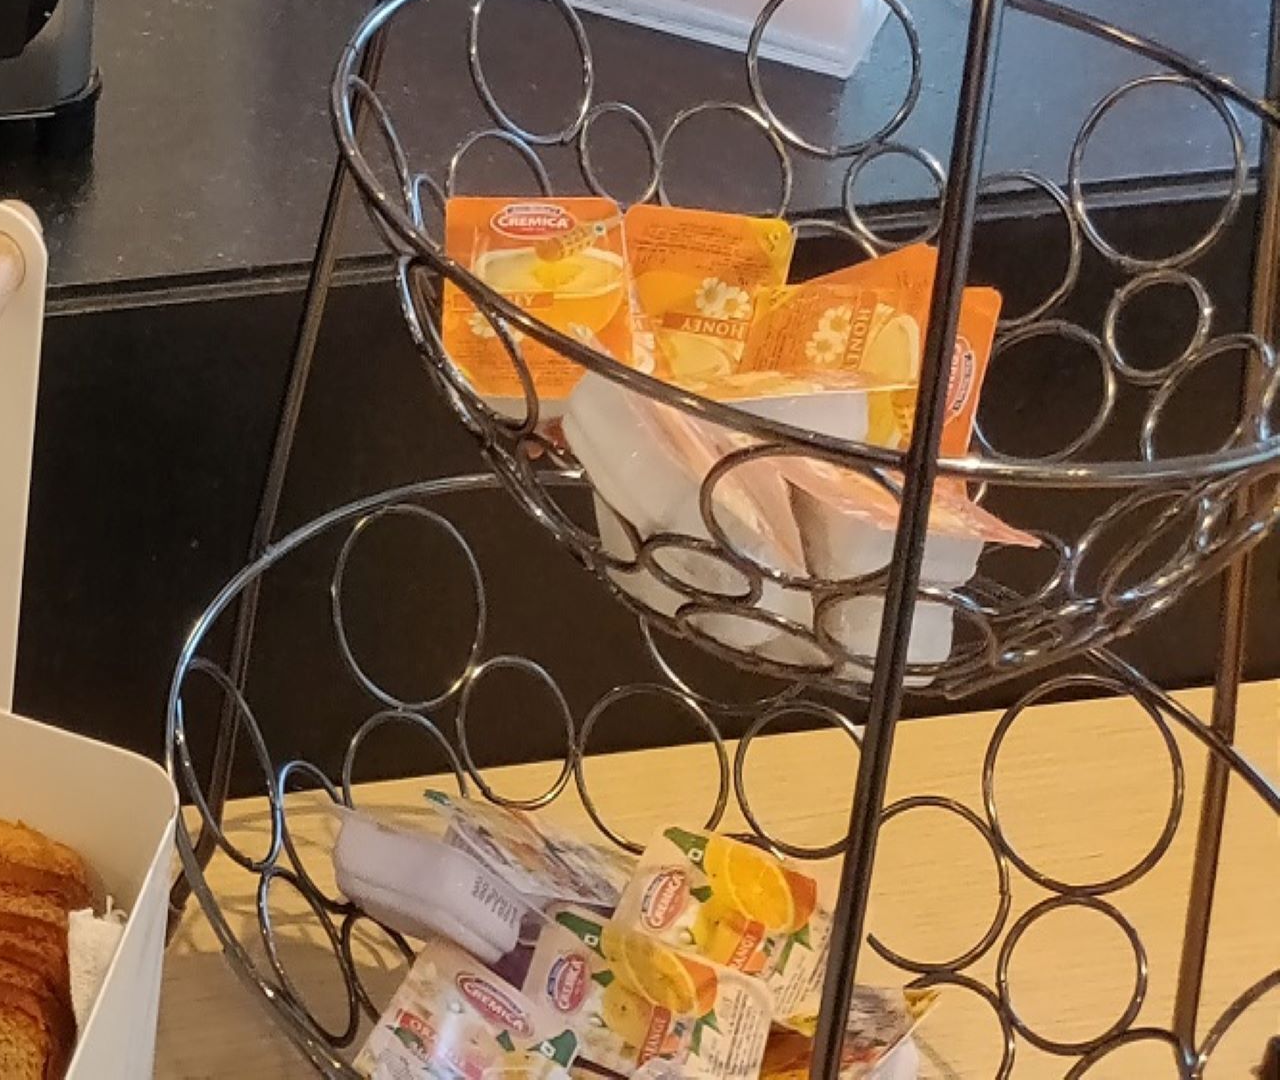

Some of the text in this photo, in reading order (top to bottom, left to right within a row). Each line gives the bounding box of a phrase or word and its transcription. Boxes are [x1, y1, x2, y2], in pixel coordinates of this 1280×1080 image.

[496, 215, 569, 230] CREMICA
[680, 317, 746, 340] HONEY
[462, 981, 525, 1033] CREMICA
